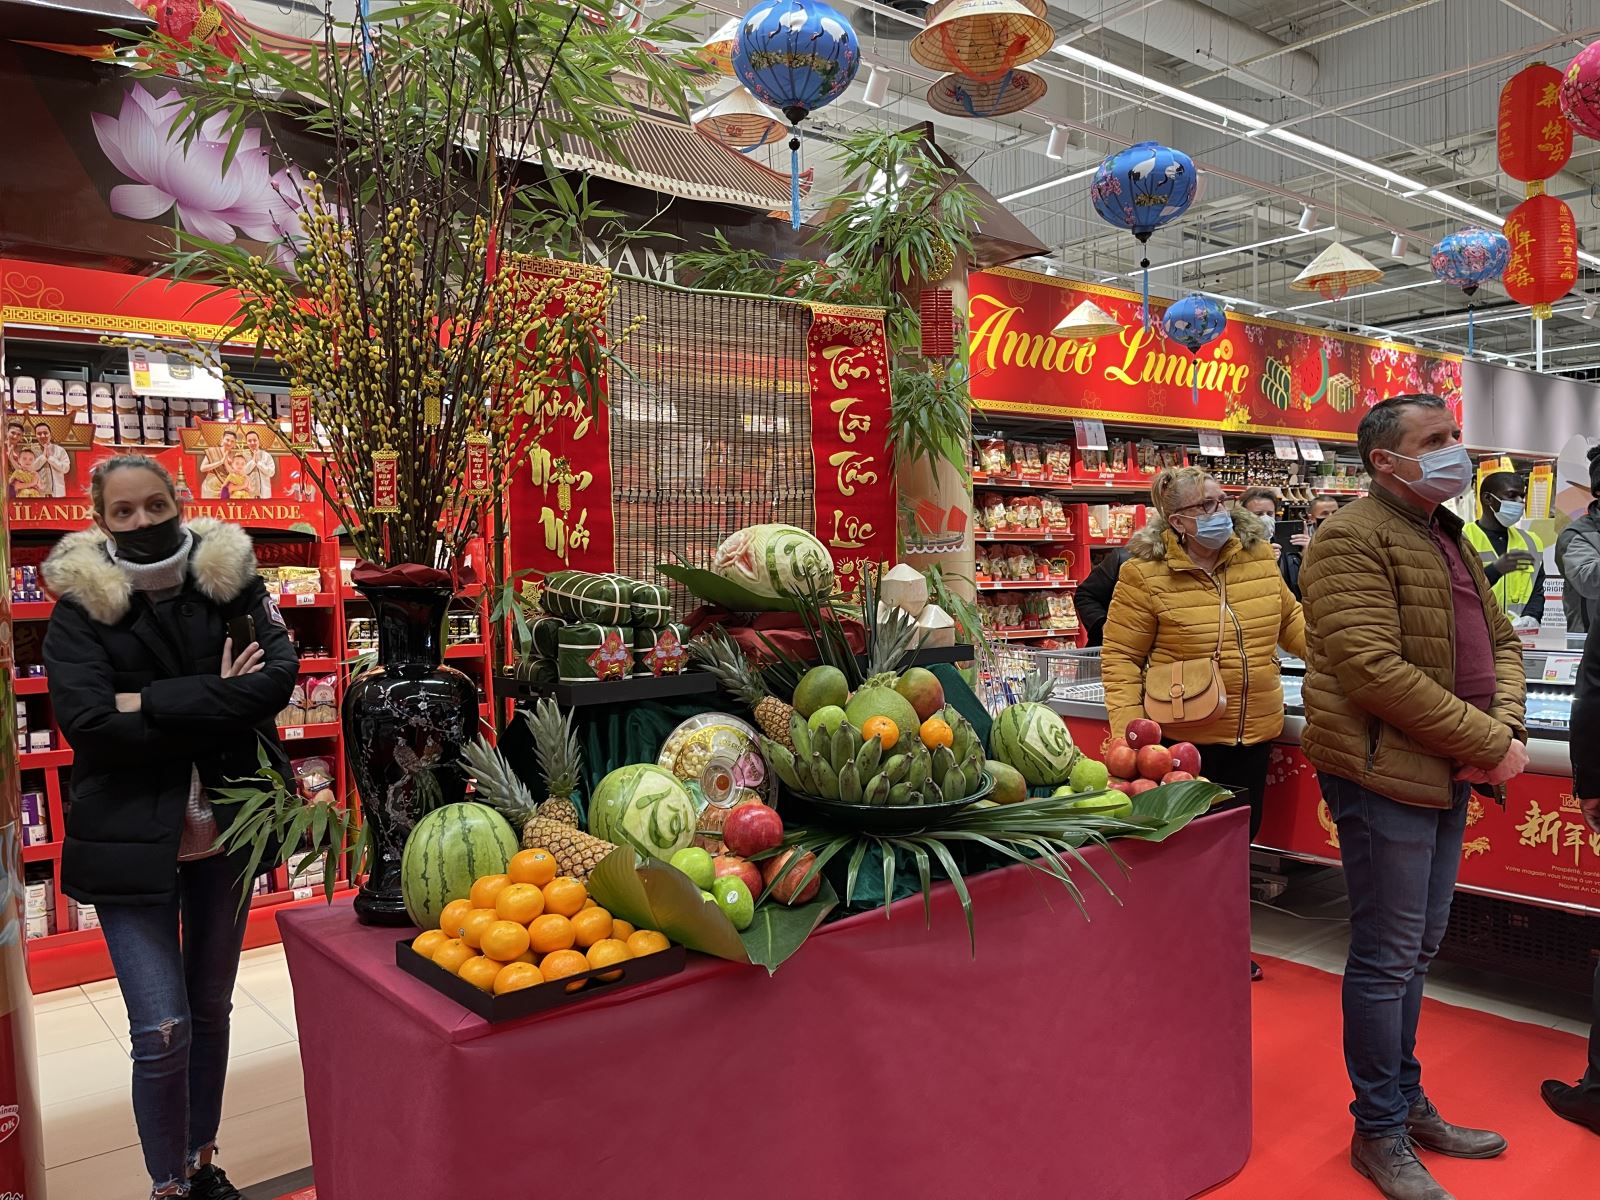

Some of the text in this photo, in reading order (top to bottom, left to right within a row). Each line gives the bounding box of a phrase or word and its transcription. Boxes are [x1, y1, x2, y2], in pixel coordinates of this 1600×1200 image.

[822, 345, 870, 390] Tấn
[1104, 323, 1250, 394] Lunaire
[830, 397, 871, 443] Tài
[828, 450, 878, 497] Tấn
[9, 502, 94, 522] ÏLAND
[182, 503, 301, 521] THAÏLANDE
[1505, 865, 1521, 873] Votre
[1522, 869, 1547, 877] magasin
[1558, 882, 1579, 891] Nouvel
